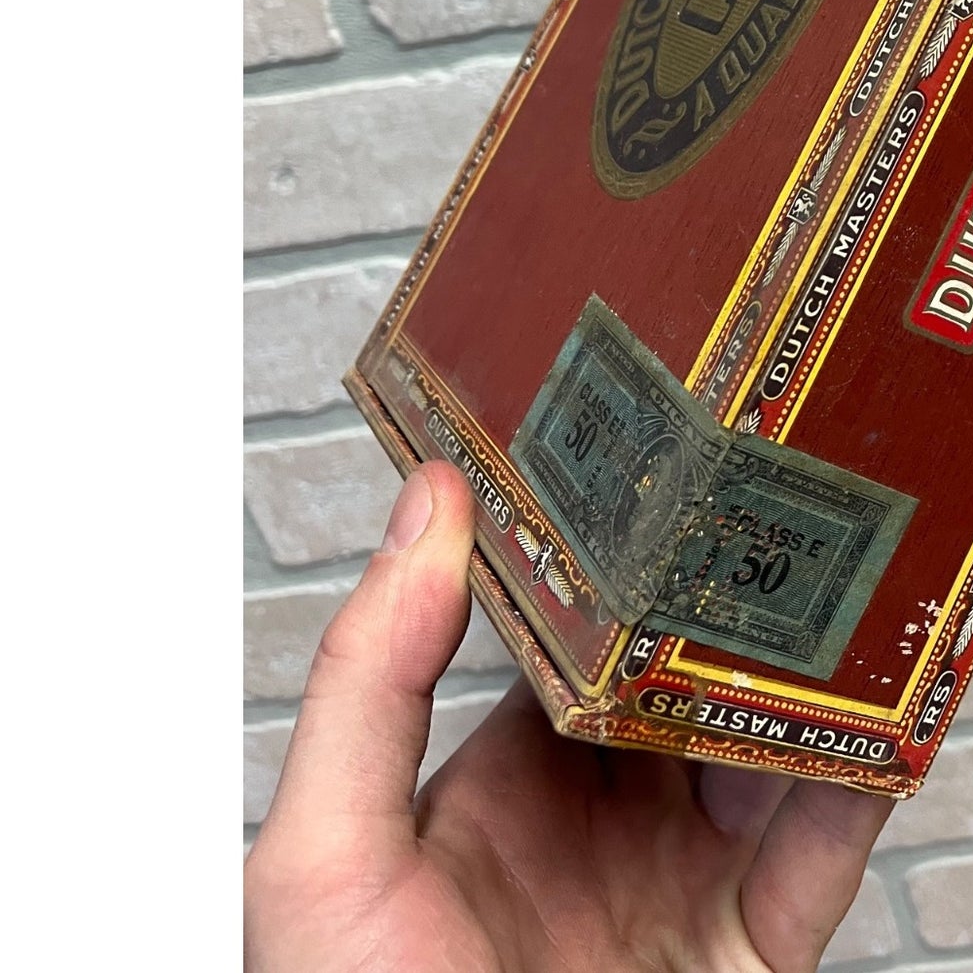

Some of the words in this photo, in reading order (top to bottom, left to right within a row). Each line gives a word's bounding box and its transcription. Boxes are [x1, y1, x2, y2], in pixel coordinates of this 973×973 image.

[858, 1, 914, 103] DUTCH
[693, 82, 716, 132] A
[770, 274, 835, 384] DUTCH
[833, 103, 920, 259] MASTERS
[705, 316, 754, 404] TERS
[580, 382, 611, 425] CLASS
[565, 409, 598, 462] 50
[428, 413, 462, 460] DUTCH
[463, 454, 510, 526] MASTERS
[736, 512, 807, 552] CLASS
[806, 535, 826, 559] E
[732, 541, 791, 595] 50
[649, 693, 789, 738] MASTERS
[925, 683, 950, 726] RS
[800, 734, 888, 759] DUTCH
